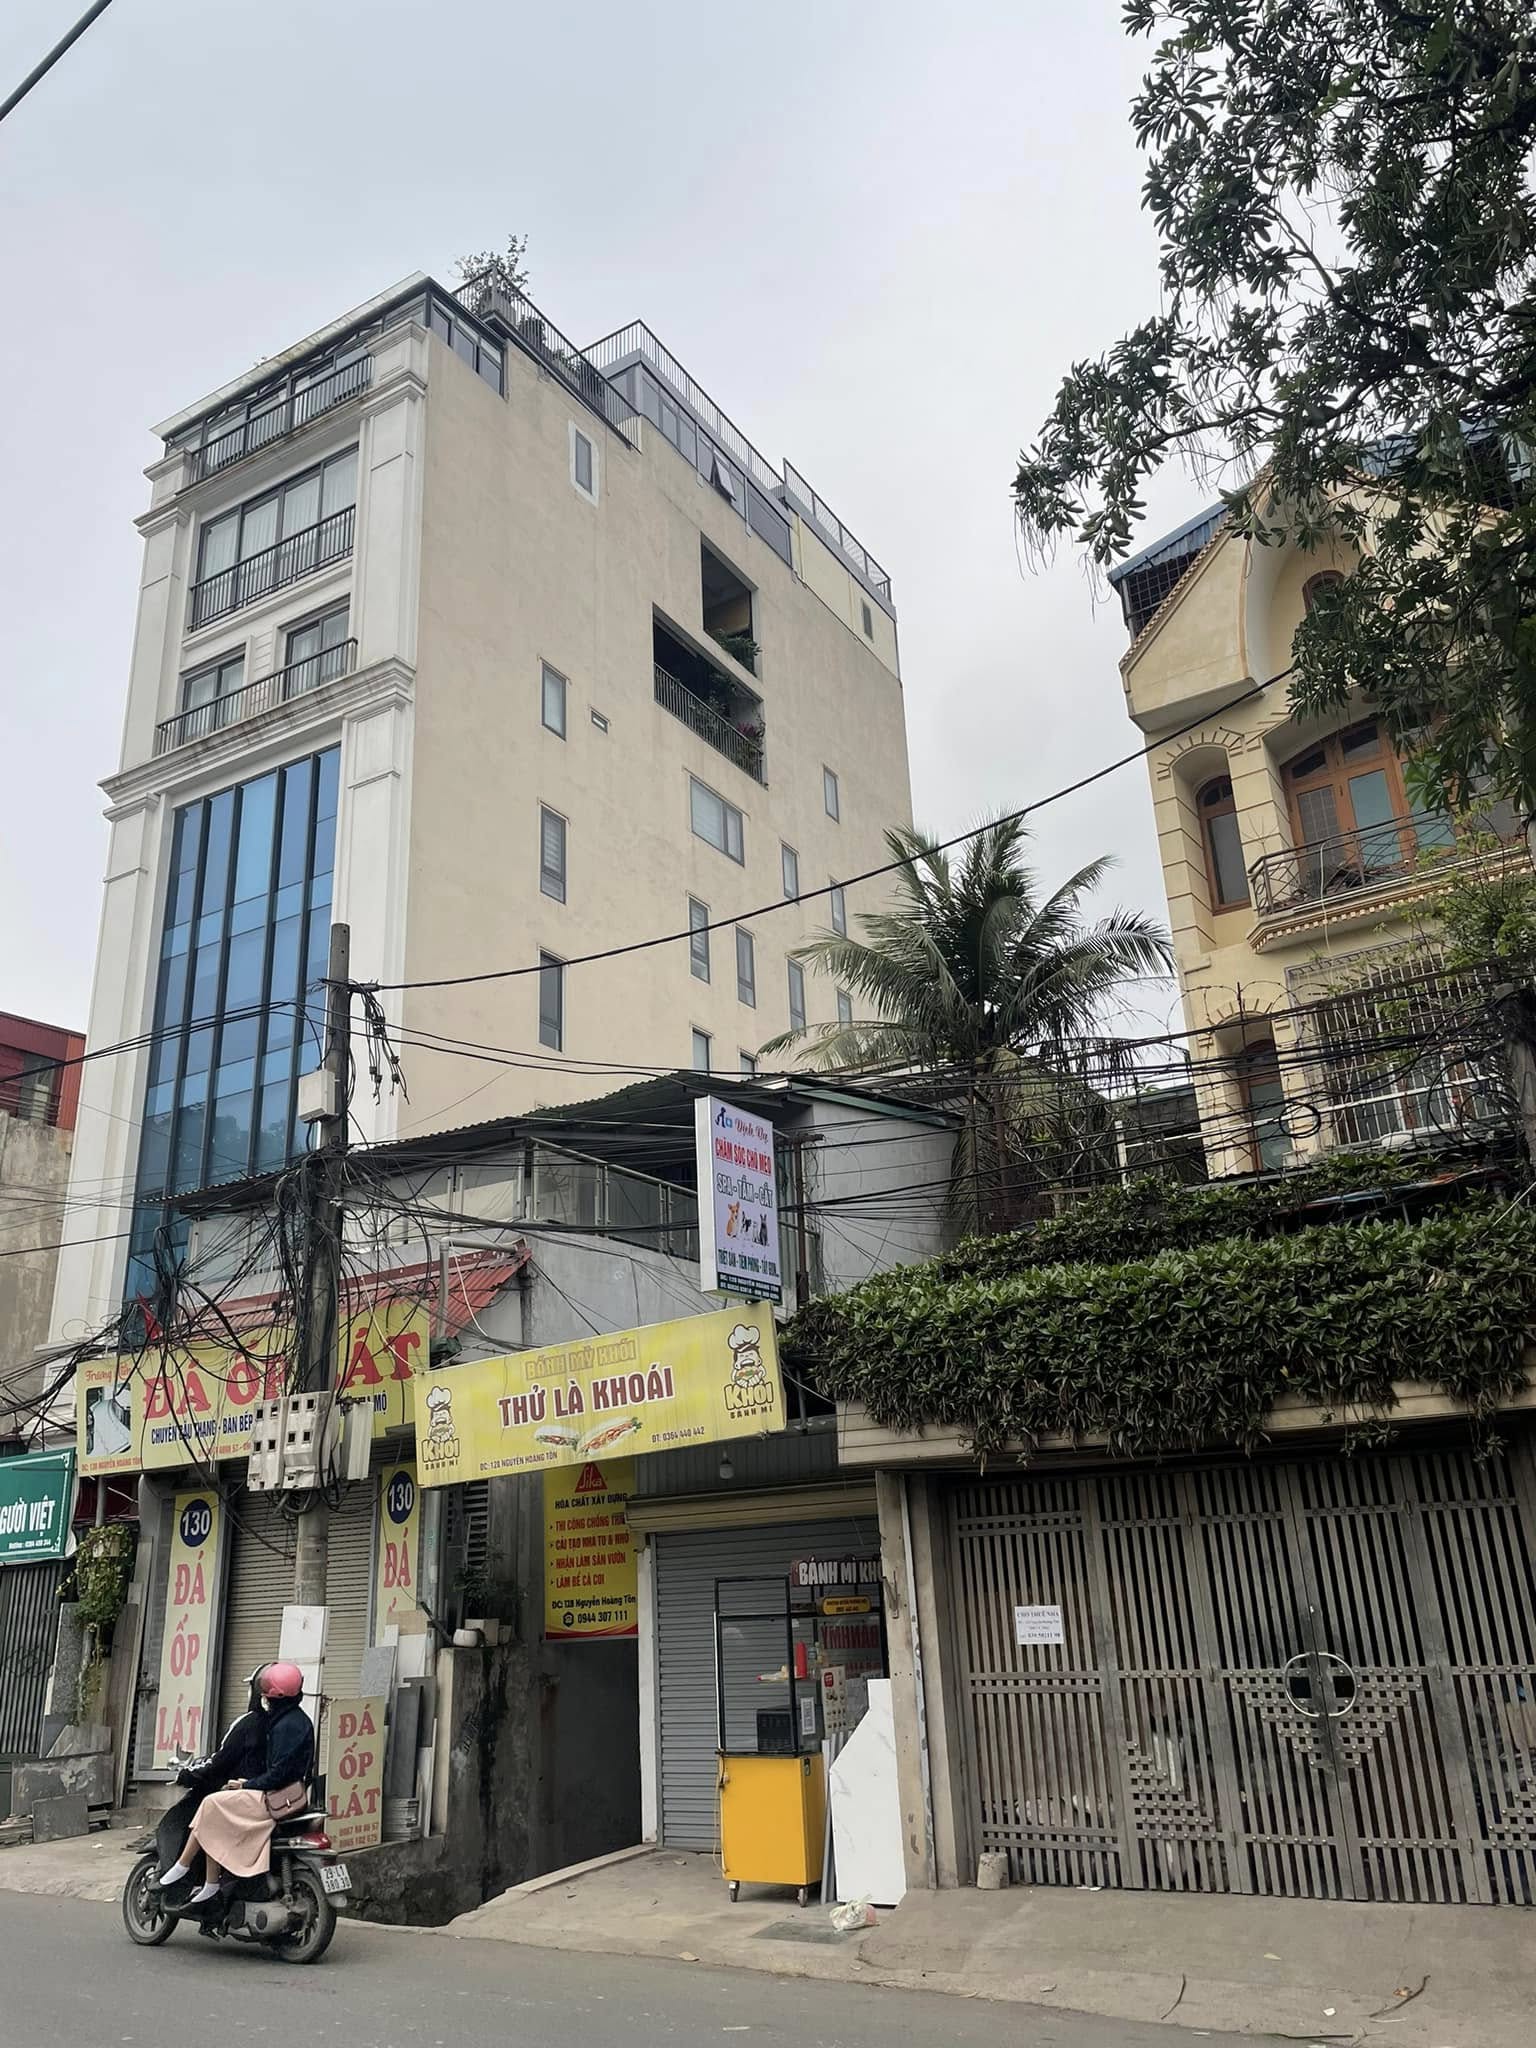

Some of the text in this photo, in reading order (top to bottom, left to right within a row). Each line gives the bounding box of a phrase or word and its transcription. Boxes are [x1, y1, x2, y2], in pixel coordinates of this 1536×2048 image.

[716, 1172, 733, 1196] SPA
[143, 1358, 211, 1420] ĐÁ
[335, 1327, 421, 1392] ÁT
[526, 1355, 567, 1380] BÁNH
[498, 1364, 674, 1427] THỬ LÀ KHOÁI
[223, 1414, 238, 1434] BÀN
[240, 1411, 254, 1431] BẾP
[0, 1495, 56, 1537] GƯỜI VIỆT
[389, 1482, 413, 1513] 130
[181, 1509, 211, 1537] 130
[384, 1527, 411, 1588] ĐÁ
[799, 1555, 838, 1585] BÁNH
[841, 1556, 857, 1583] MÌ
[173, 1551, 205, 1606] ĐÁ
[614, 1609, 628, 1621] 111
[170, 1613, 200, 1677] ỐP
[157, 1693, 201, 1751] LÁT
[338, 1704, 377, 1739] ĐÁ
[338, 1742, 374, 1780] ỐP
[329, 1784, 381, 1821] LÁT
